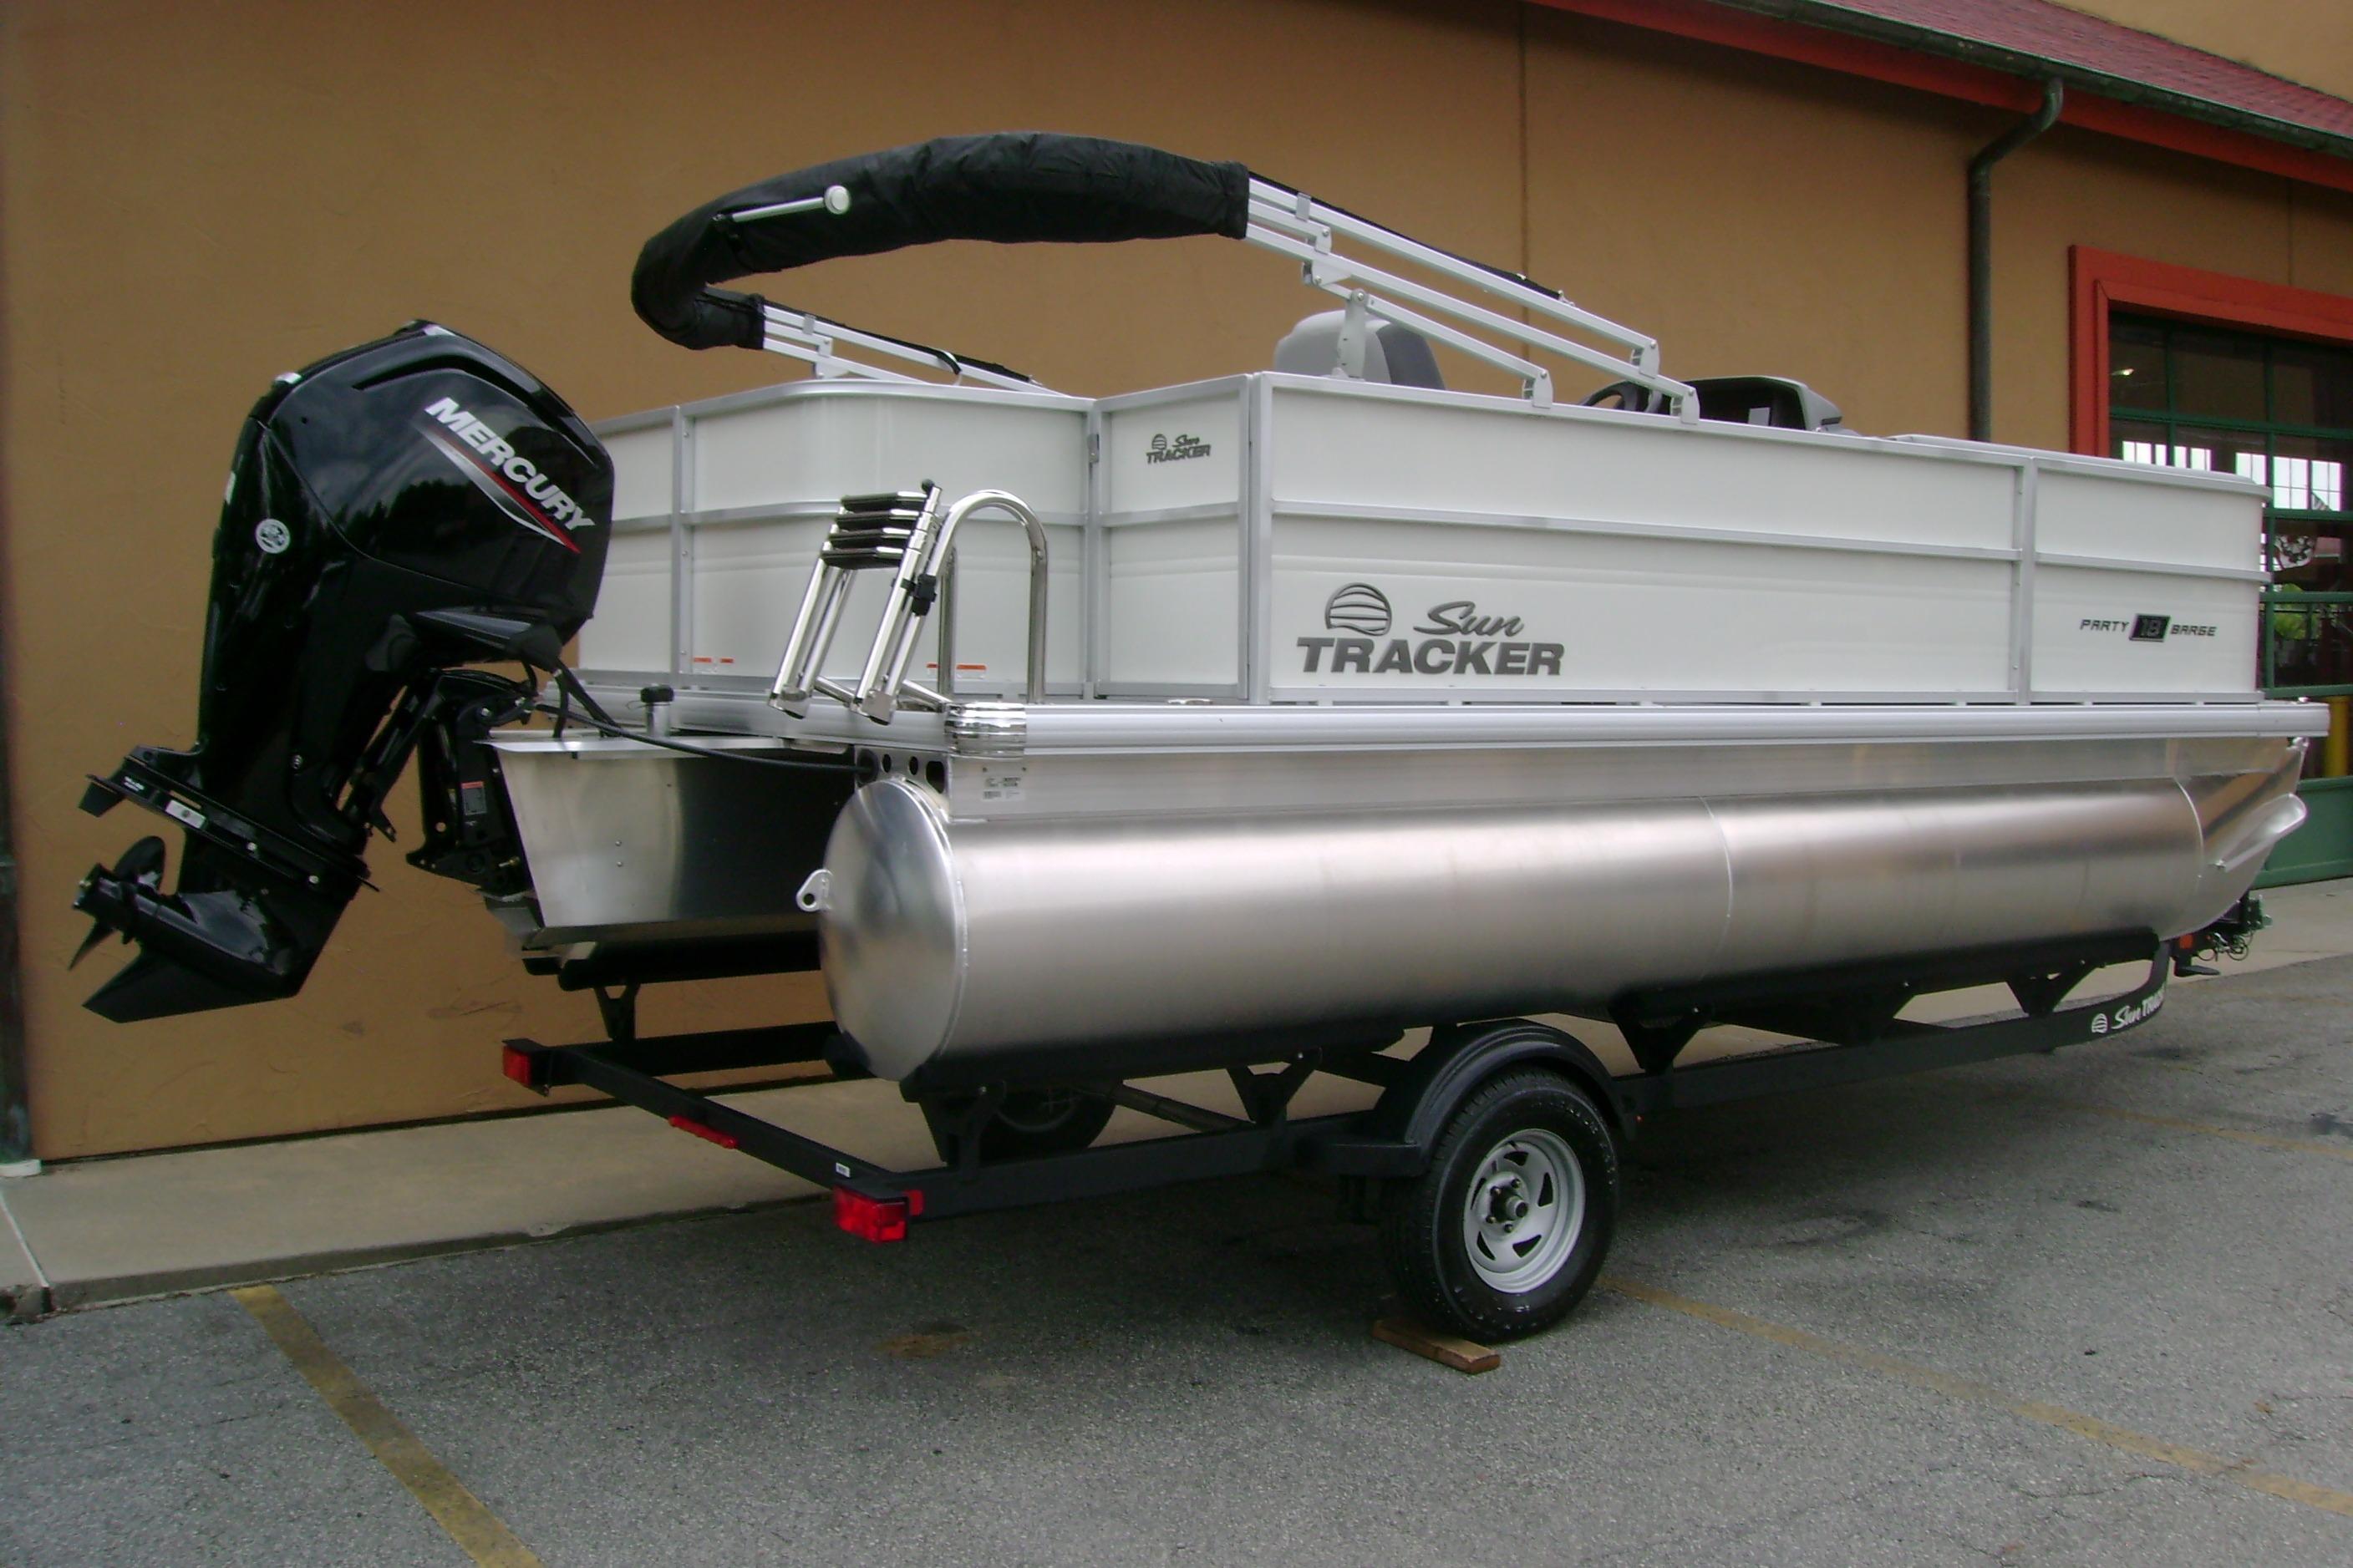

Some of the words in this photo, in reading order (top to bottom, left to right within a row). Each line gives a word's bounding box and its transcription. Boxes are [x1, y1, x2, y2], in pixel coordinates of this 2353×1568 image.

[1171, 434, 1200, 448] Sun
[424, 397, 596, 530] MERCURY
[1146, 444, 1211, 464] TRACKER
[1413, 601, 1524, 637] Sun
[2080, 619, 2129, 632] PARTY
[2170, 624, 2217, 637] BARGE
[1296, 637, 1564, 676] TRACKER
[2111, 1005, 2141, 1029] Sun
